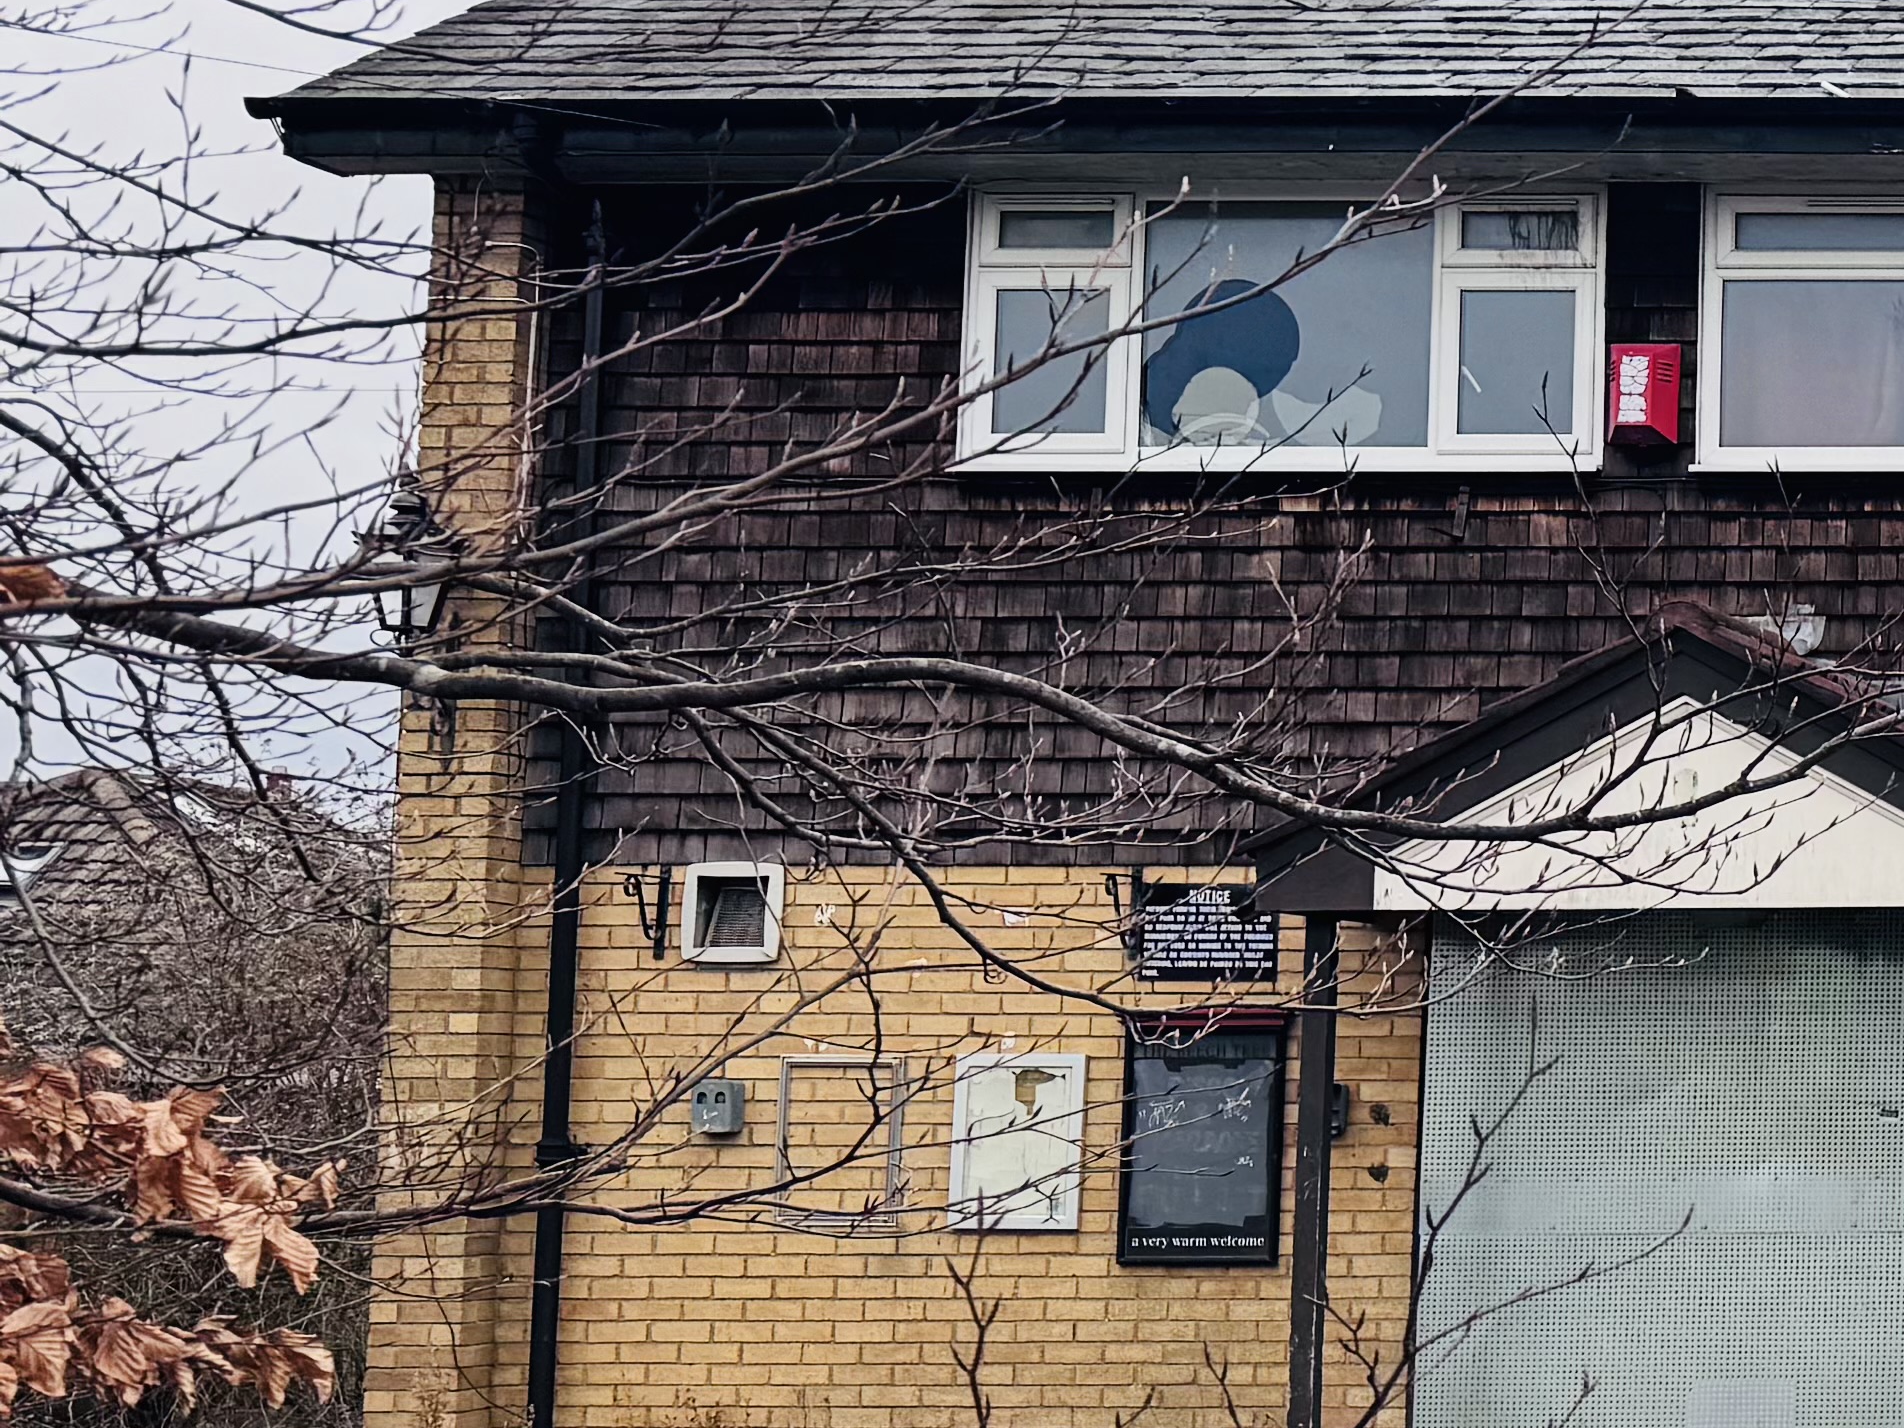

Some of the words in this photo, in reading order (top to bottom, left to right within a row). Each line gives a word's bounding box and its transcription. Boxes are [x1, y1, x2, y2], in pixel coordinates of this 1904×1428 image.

[1189, 889, 1231, 904] NOTICE
[1131, 1236, 1139, 1247] a
[1142, 1236, 1168, 1249] very
[1172, 1236, 1207, 1247] warm
[1210, 1235, 1265, 1247] welcome
